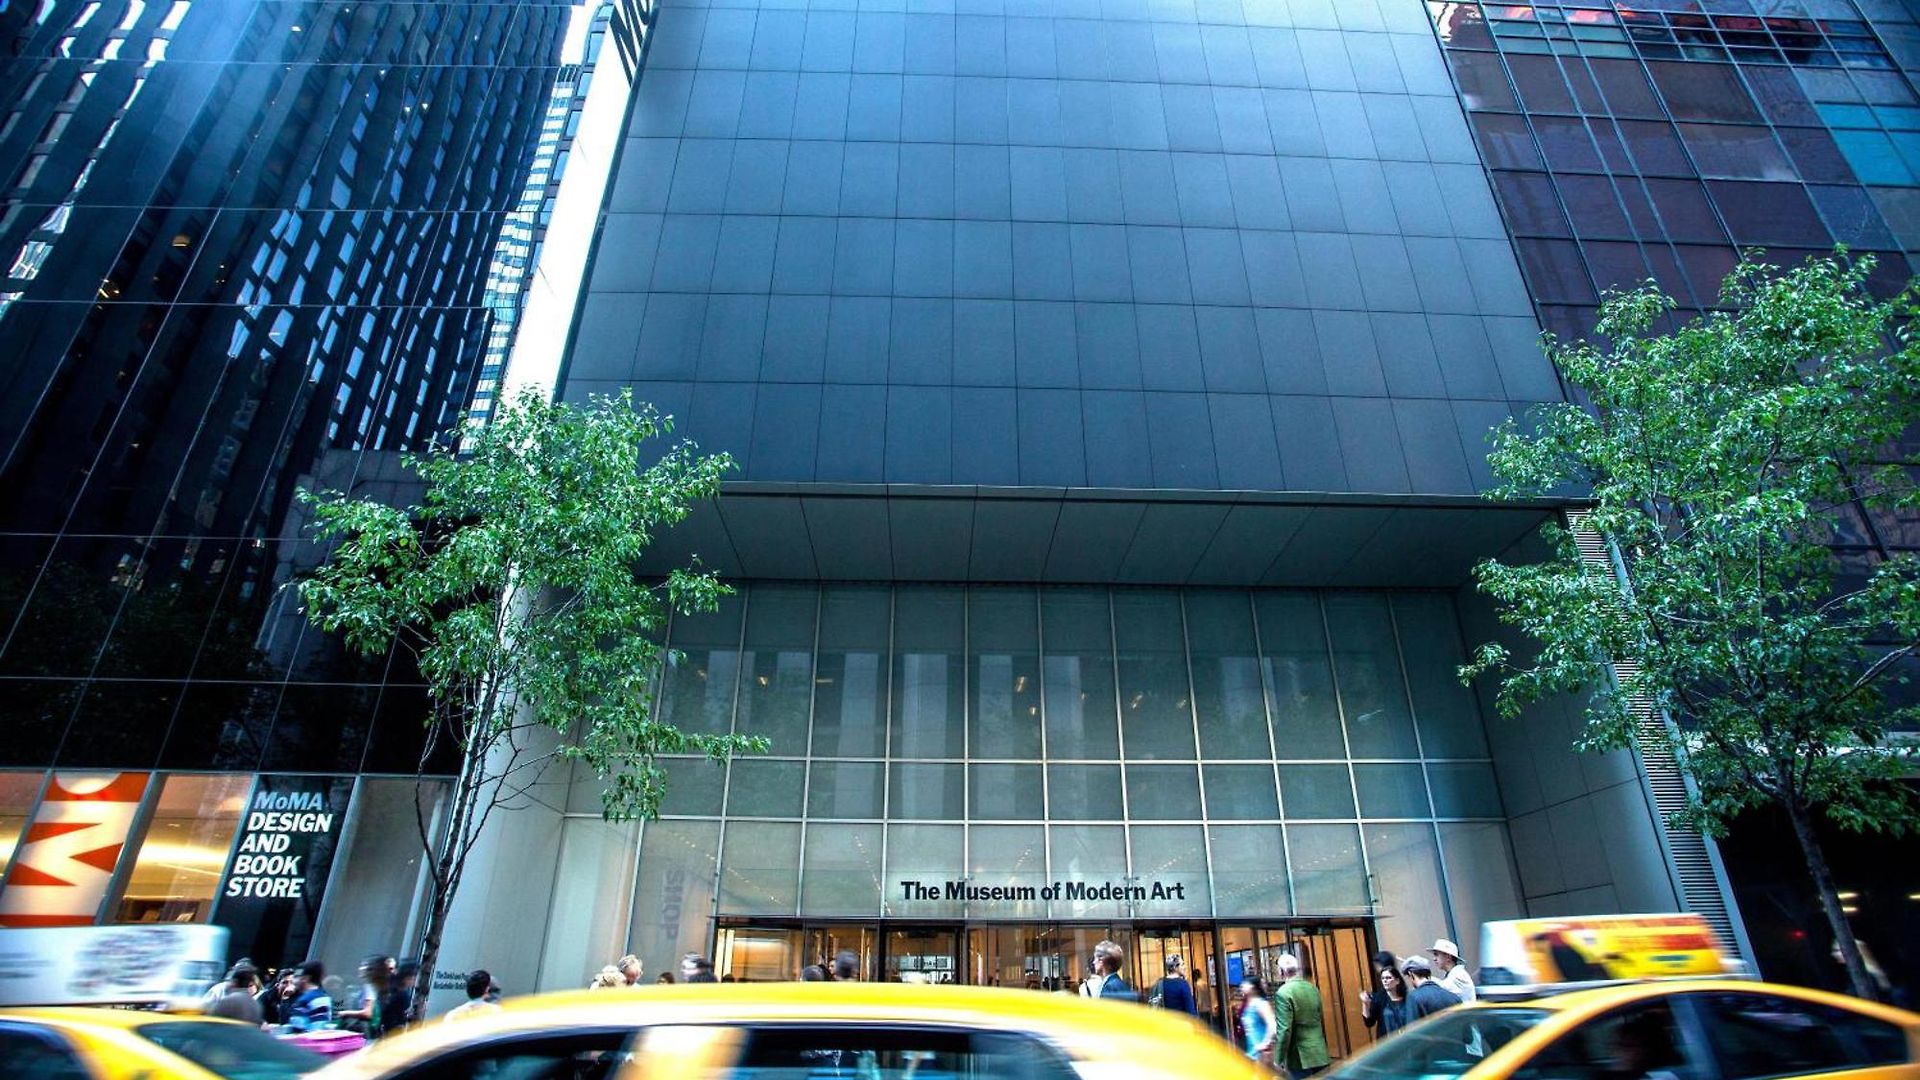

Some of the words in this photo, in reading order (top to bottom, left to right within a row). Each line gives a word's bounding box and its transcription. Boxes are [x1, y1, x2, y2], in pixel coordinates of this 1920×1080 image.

[254, 791, 323, 811] MoMA
[247, 812, 333, 832] DESIGN
[240, 833, 291, 853] AND
[233, 854, 302, 875] BOOK
[226, 876, 305, 898] STORE
[901, 881, 940, 900] The
[945, 881, 1036, 900] Museum
[1040, 881, 1062, 900] of
[1066, 881, 1146, 900] Modern
[1150, 881, 1185, 900] Art
